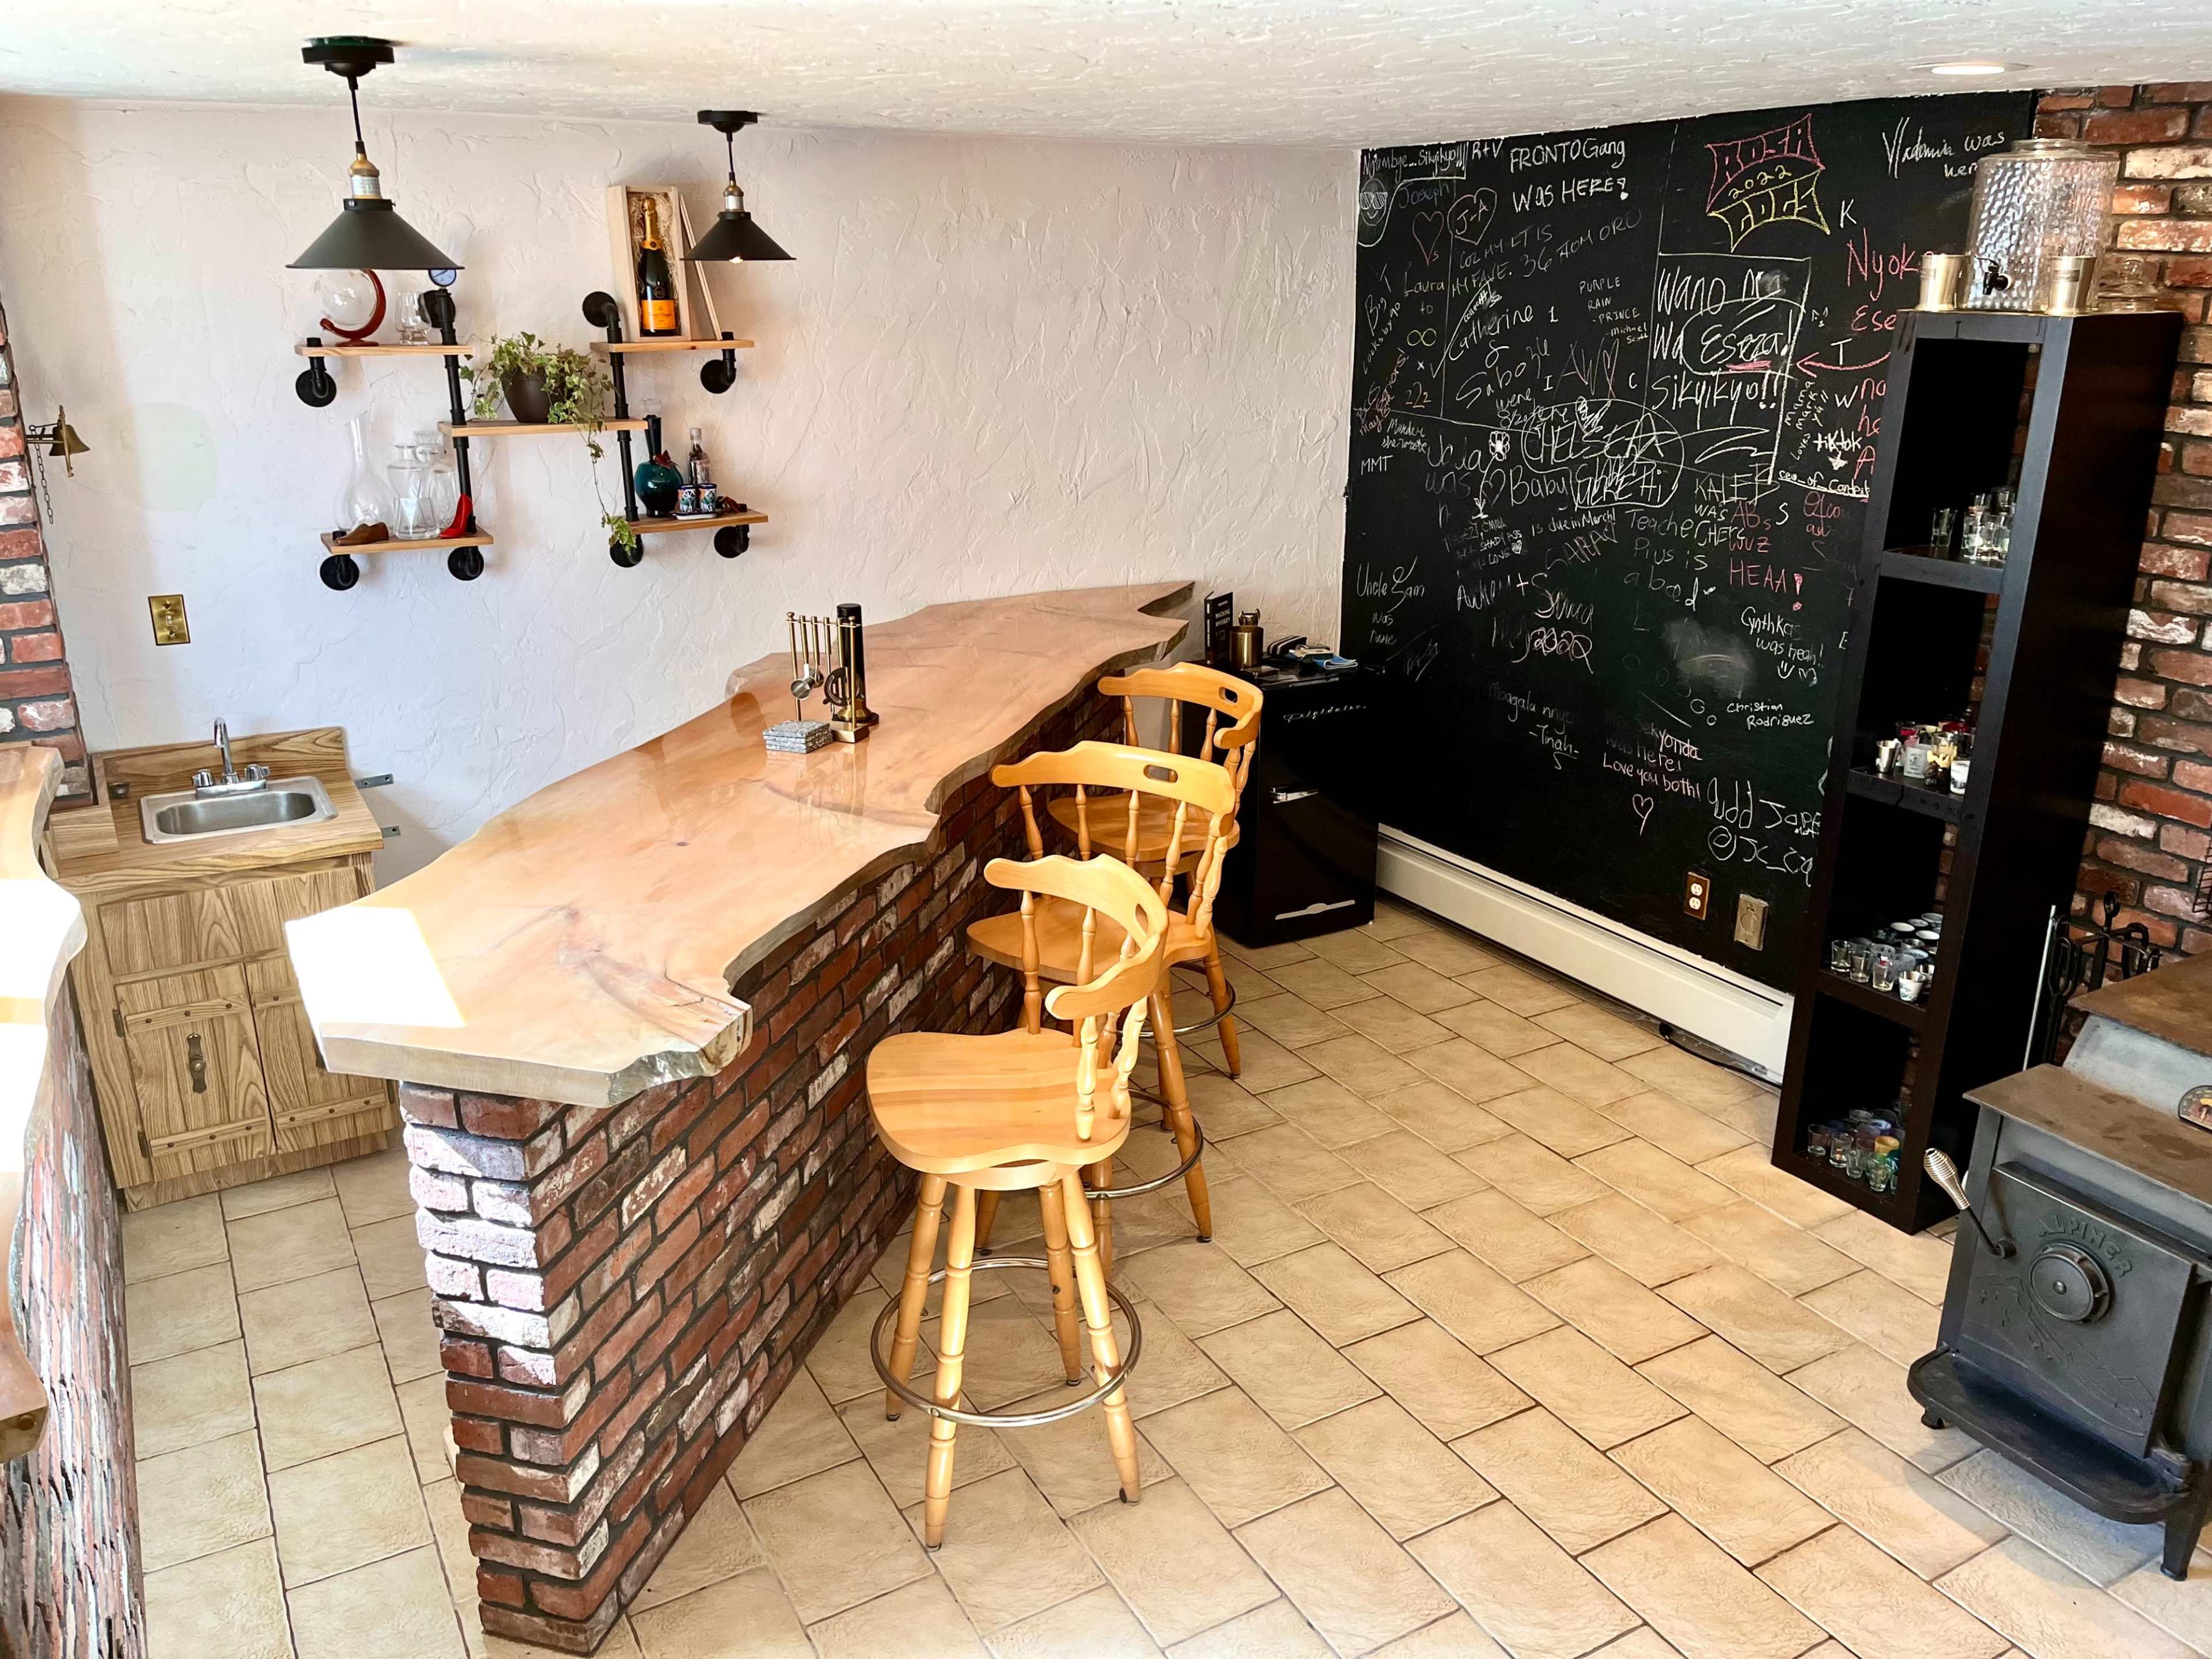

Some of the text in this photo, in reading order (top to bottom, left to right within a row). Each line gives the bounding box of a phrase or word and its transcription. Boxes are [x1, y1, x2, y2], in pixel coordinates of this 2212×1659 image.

[1965, 131, 2006, 152] was
[1728, 165, 1792, 199] 2022
[1404, 271, 1445, 297] Laura
[1580, 276, 1622, 294] PURPLE
[1588, 296, 1612, 312] RAIN
[1361, 454, 1394, 476] MMT
[1603, 752, 1633, 777] Love
[2038, 1214, 2135, 1279] ALPINER
